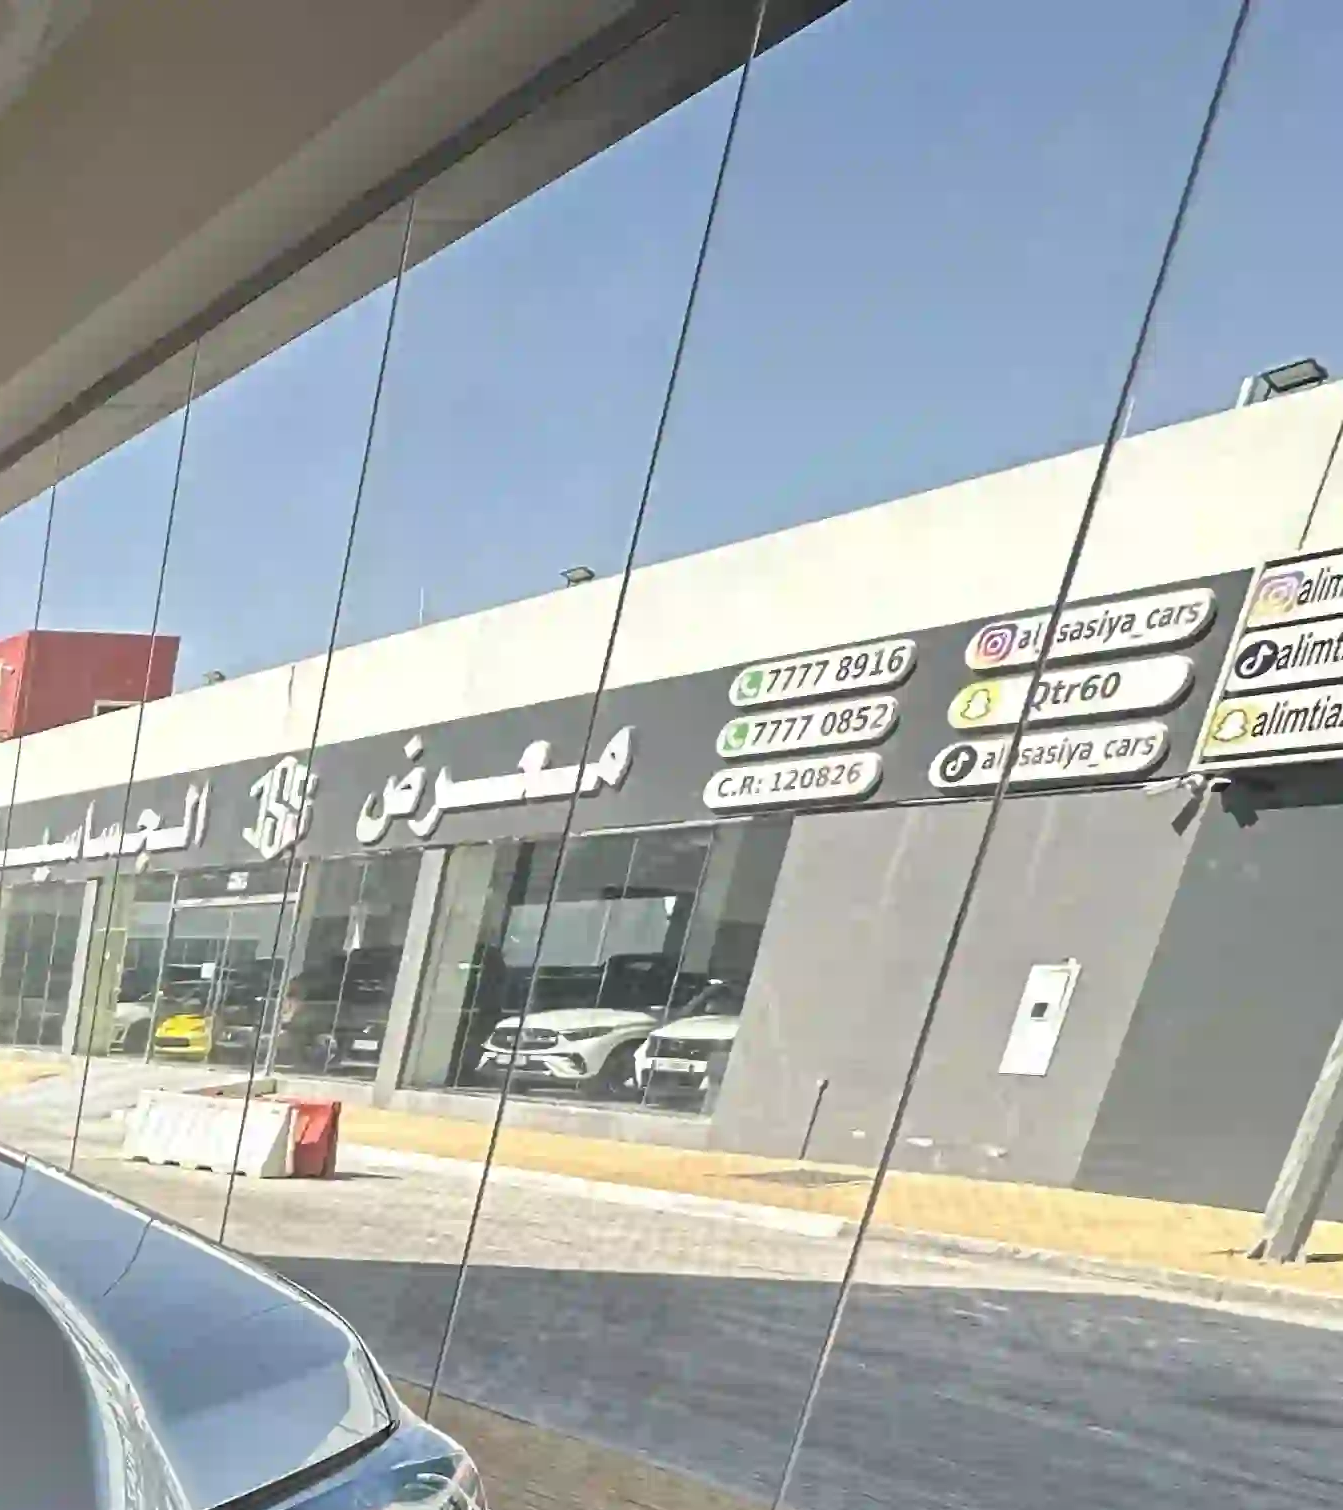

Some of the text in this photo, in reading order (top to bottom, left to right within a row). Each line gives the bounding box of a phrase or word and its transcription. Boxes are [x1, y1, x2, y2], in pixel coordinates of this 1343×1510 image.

[1018, 601, 1203, 650] alsasiya_cars
[767, 646, 906, 692] 7777 8916
[1276, 632, 1343, 670] alimt
[752, 704, 888, 745] 7777 0852
[1251, 696, 1343, 737] alimtia
[981, 735, 1157, 769] alsasiya_cars
[356, 725, 635, 845] معرض
[770, 762, 863, 792] 120826
